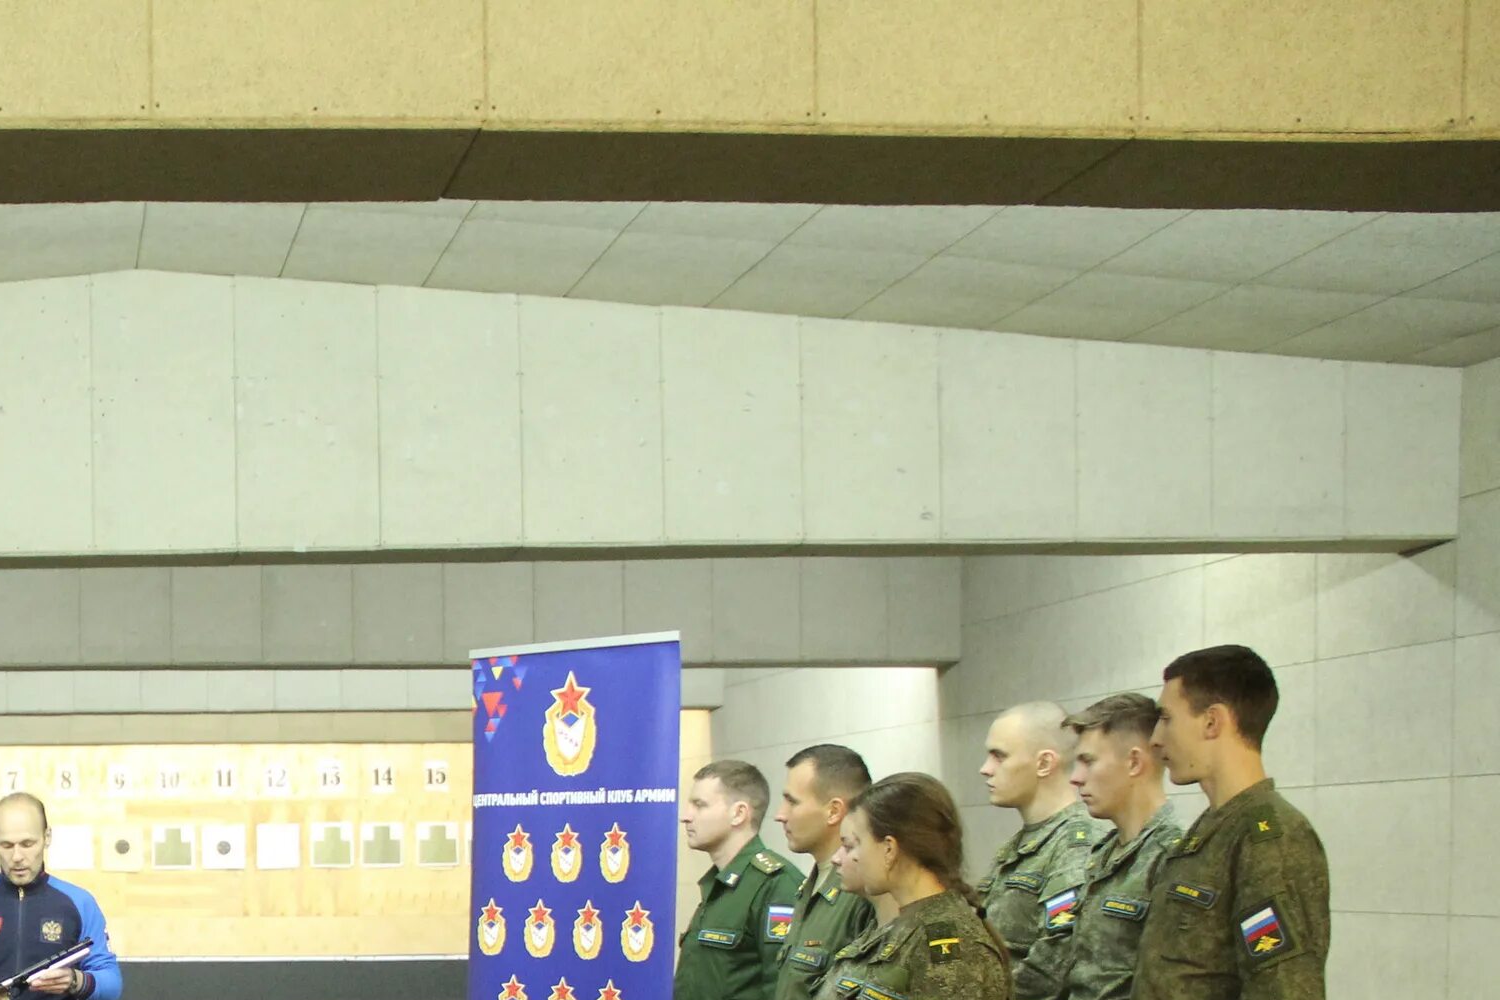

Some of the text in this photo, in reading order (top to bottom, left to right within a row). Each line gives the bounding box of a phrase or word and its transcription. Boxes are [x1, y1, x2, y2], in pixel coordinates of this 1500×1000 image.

[7, 771, 18, 790] 7
[60, 771, 72, 790] 8
[114, 774, 125, 790] 9
[160, 771, 180, 789] 10
[216, 769, 232, 788] 11
[267, 769, 287, 788] 12
[321, 766, 341, 786] 13
[373, 767, 393, 786] 14
[426, 768, 446, 785] 15
[473, 788, 676, 808] ЦЕНТРАЛЬНЫЙ СПОРТИВНЫЙ КЛУБ АРМИИ
